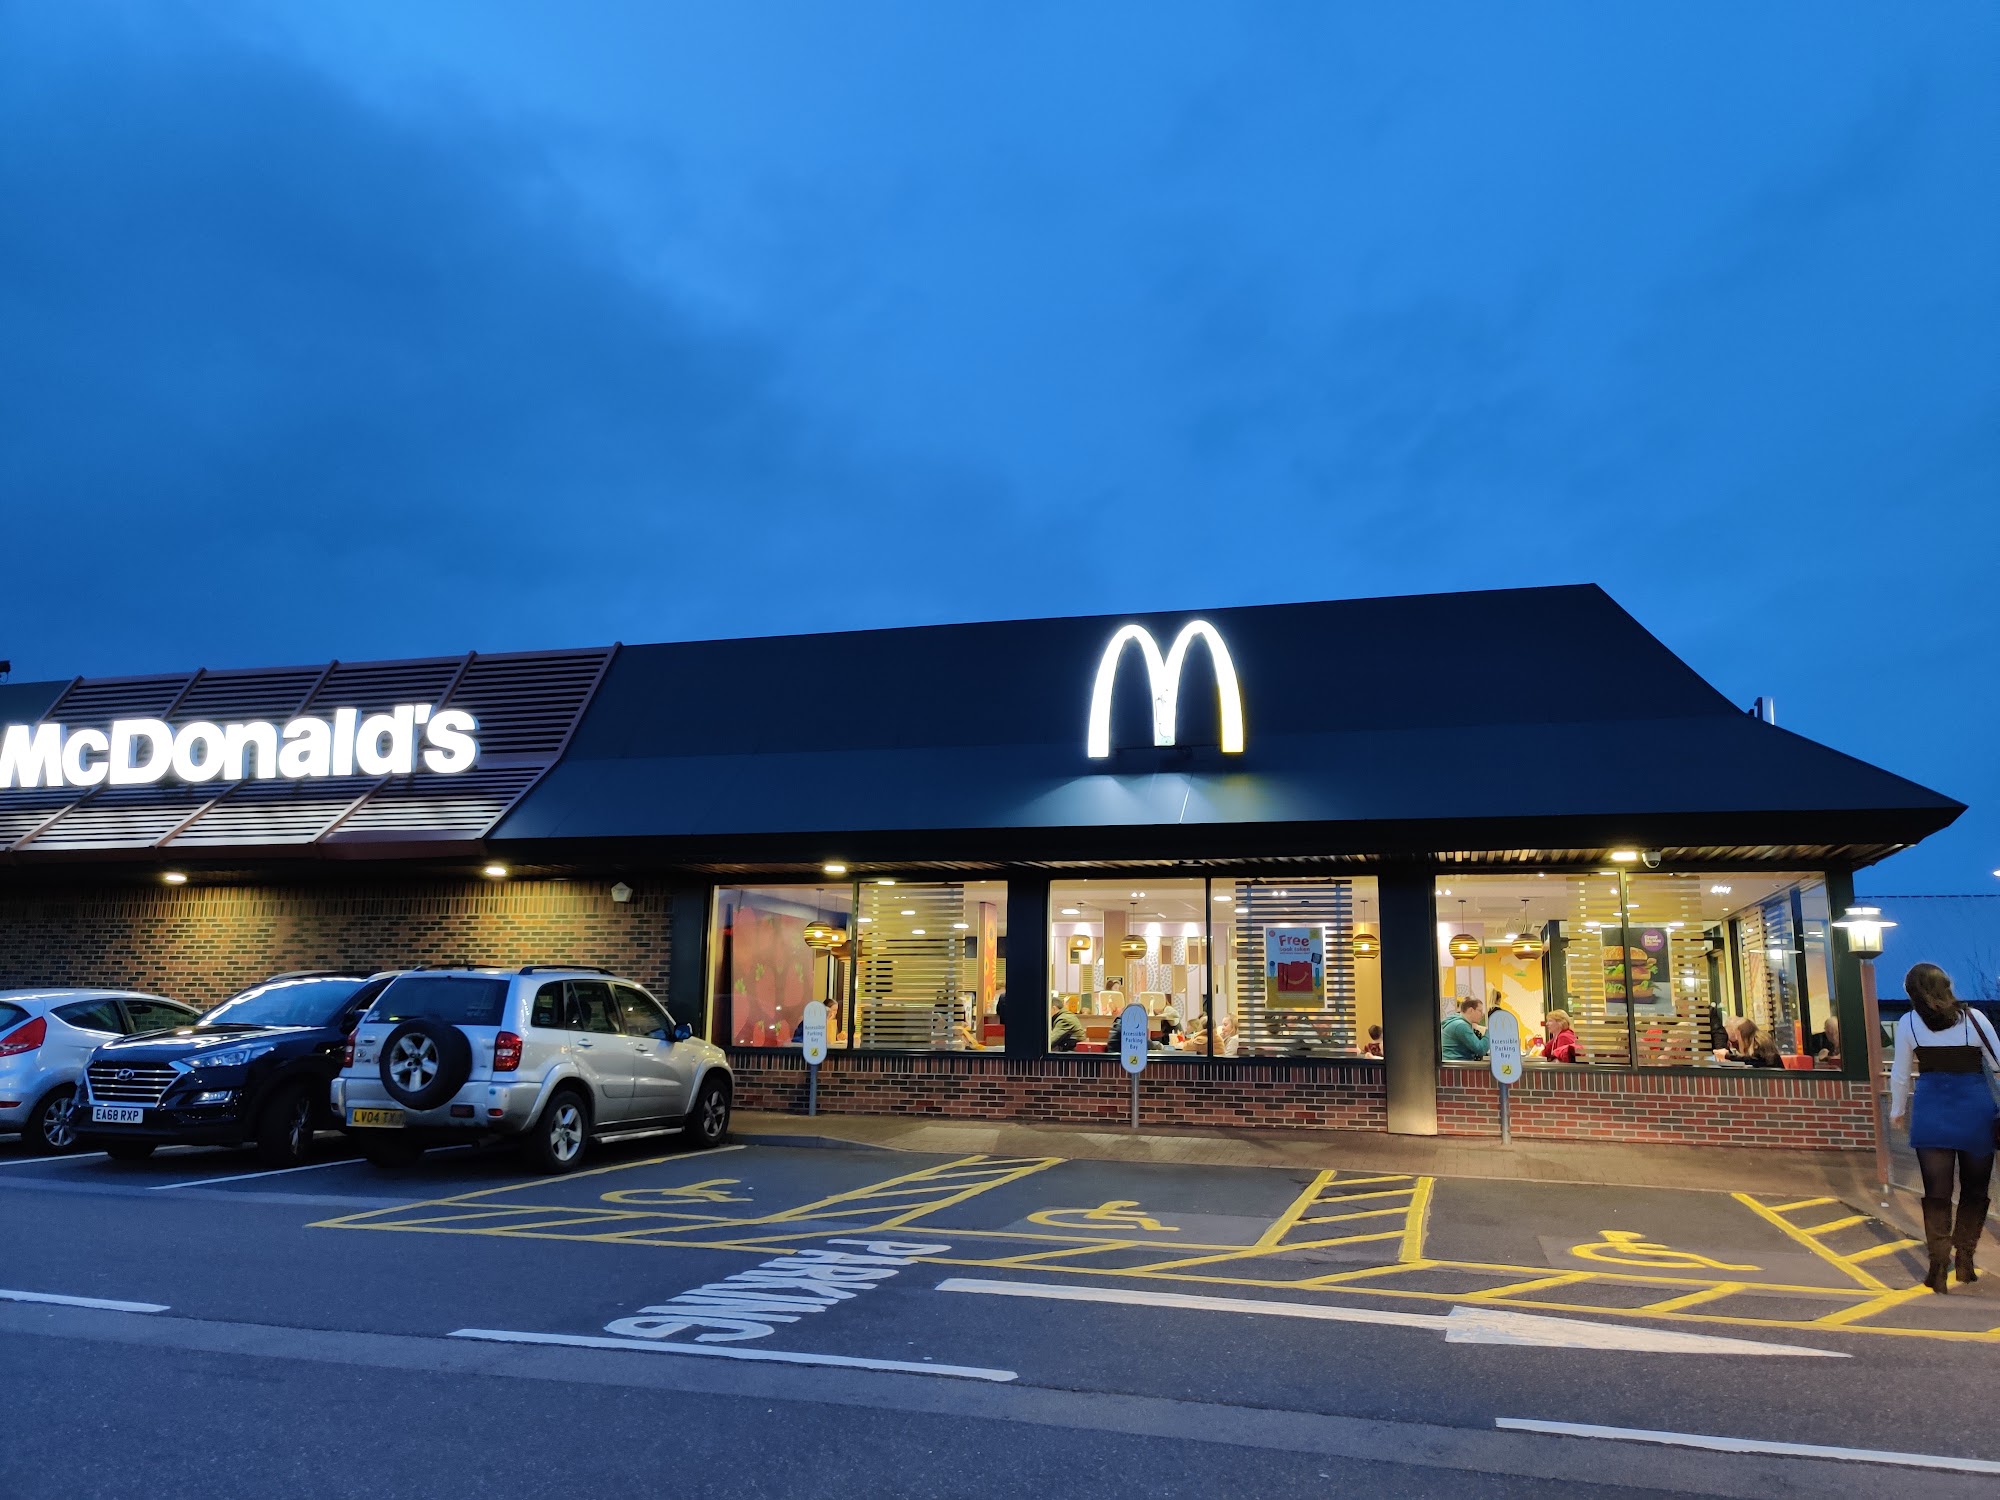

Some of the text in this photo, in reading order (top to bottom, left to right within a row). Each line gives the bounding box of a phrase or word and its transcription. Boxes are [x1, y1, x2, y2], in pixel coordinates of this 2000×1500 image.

[0, 704, 480, 788] McDonald's
[1279, 935, 1310, 946] Free
[95, 1108, 139, 1122] EA68 RXP
[353, 1109, 380, 1123] LV04
[603, 1238, 952, 1342] PARKING
